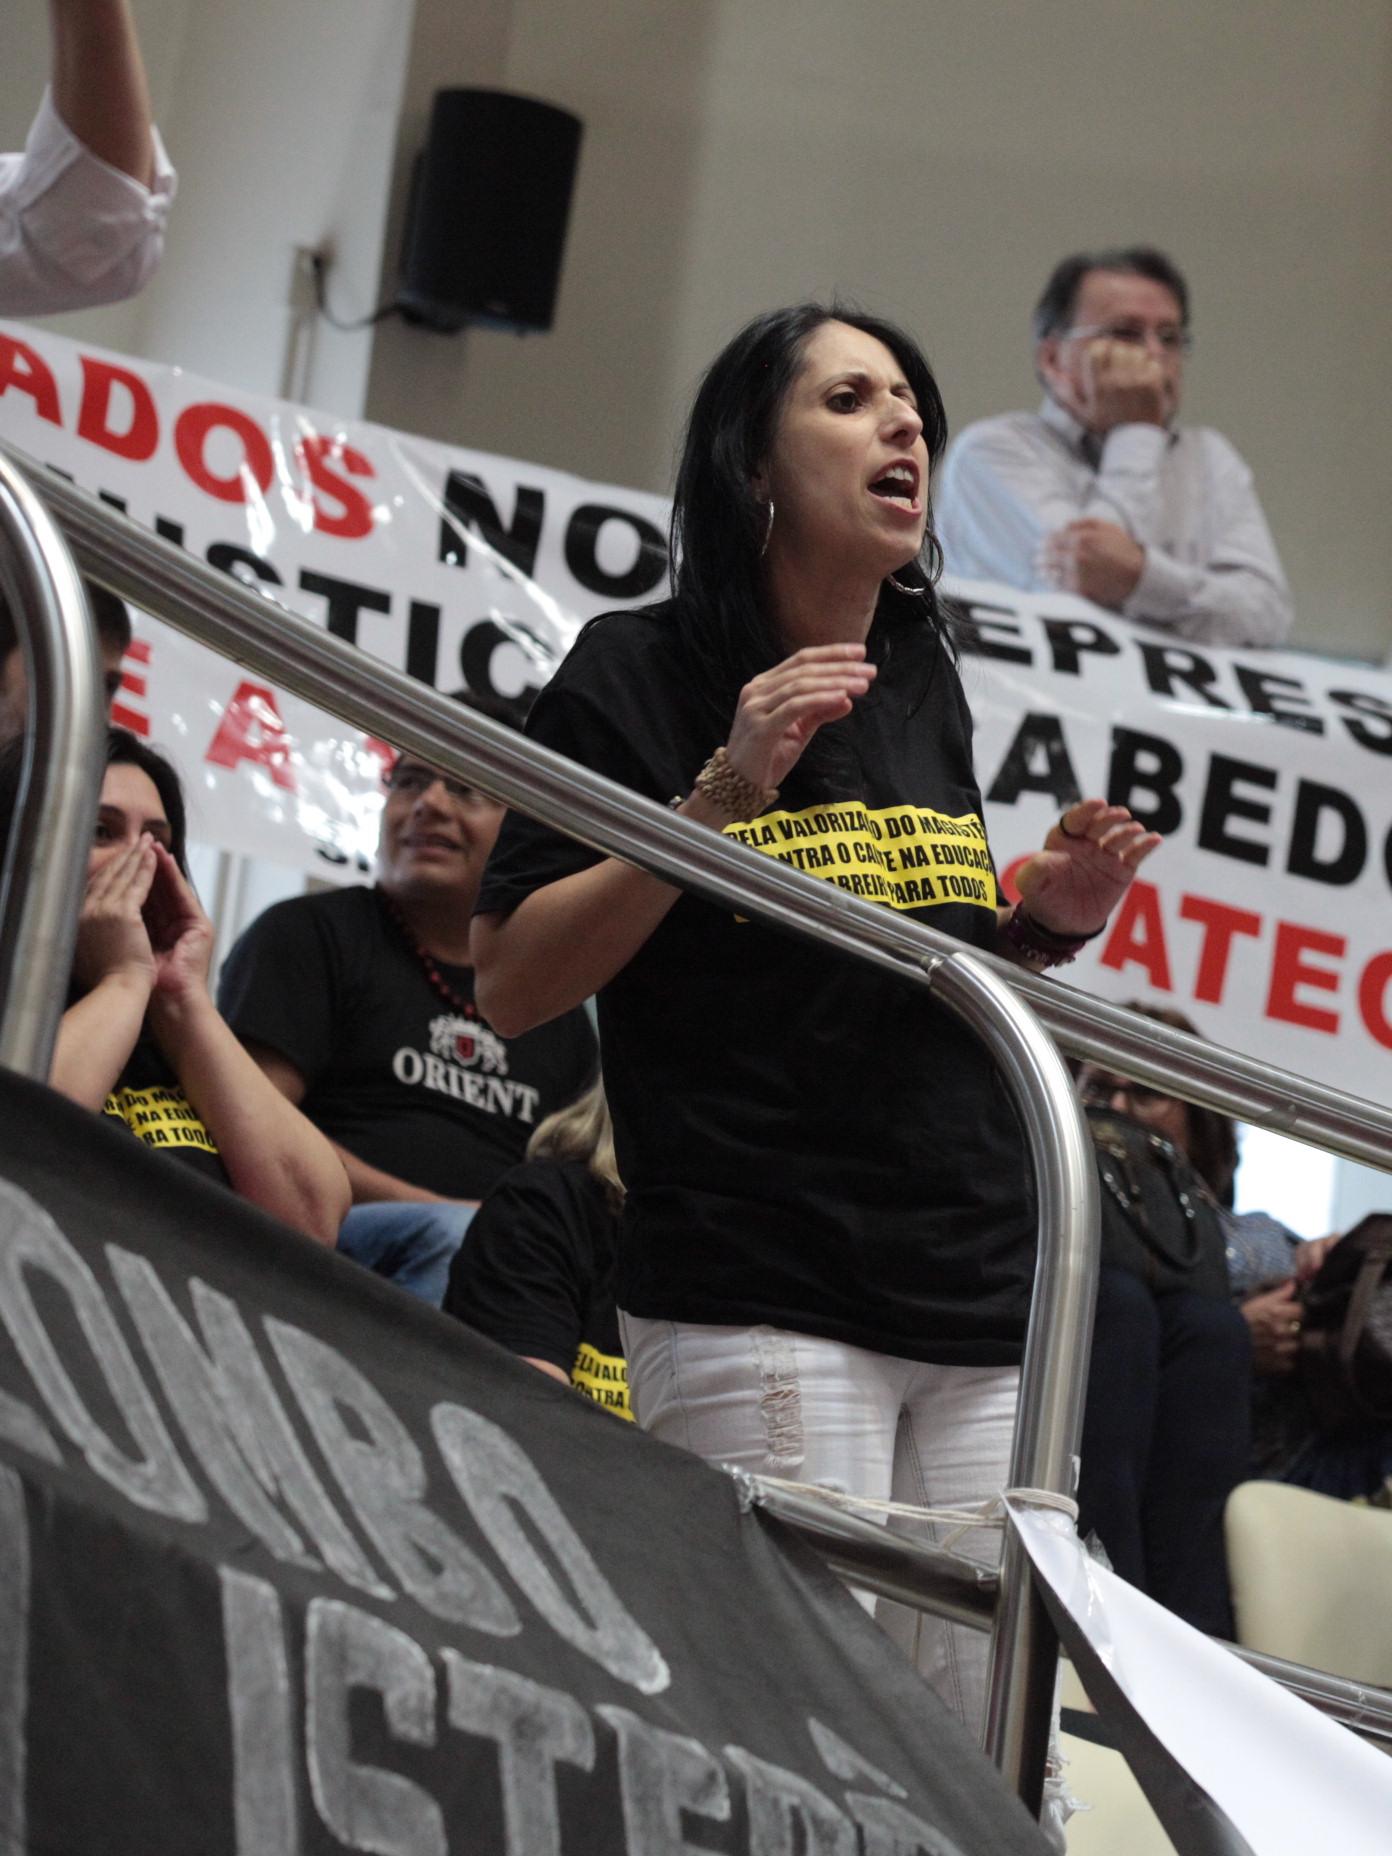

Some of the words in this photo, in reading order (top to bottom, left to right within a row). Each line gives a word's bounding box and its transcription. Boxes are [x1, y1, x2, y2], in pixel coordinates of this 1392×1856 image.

[885, 814, 916, 838] DO
[836, 842, 851, 864] O
[898, 845, 930, 869] NA
[887, 877, 937, 904] PARA
[937, 875, 988, 902] TODOS
[392, 1046, 540, 1124] ORIENT
[0, 1175, 671, 1695] OMBO
